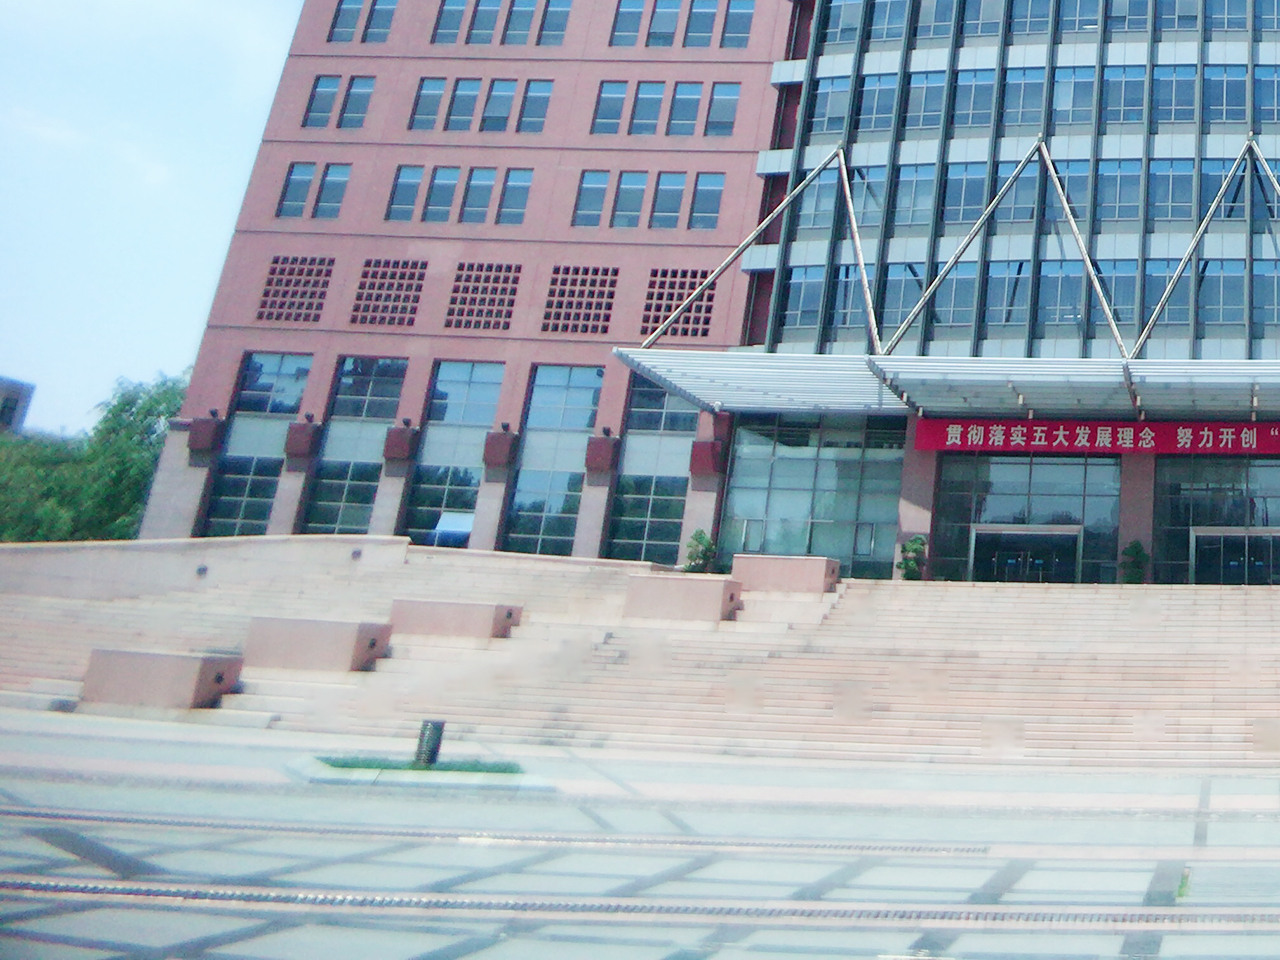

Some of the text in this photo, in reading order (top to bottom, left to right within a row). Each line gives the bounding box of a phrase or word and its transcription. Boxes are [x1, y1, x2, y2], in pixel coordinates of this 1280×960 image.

[945, 423, 1156, 448] 贯彻落实五大发展理念
